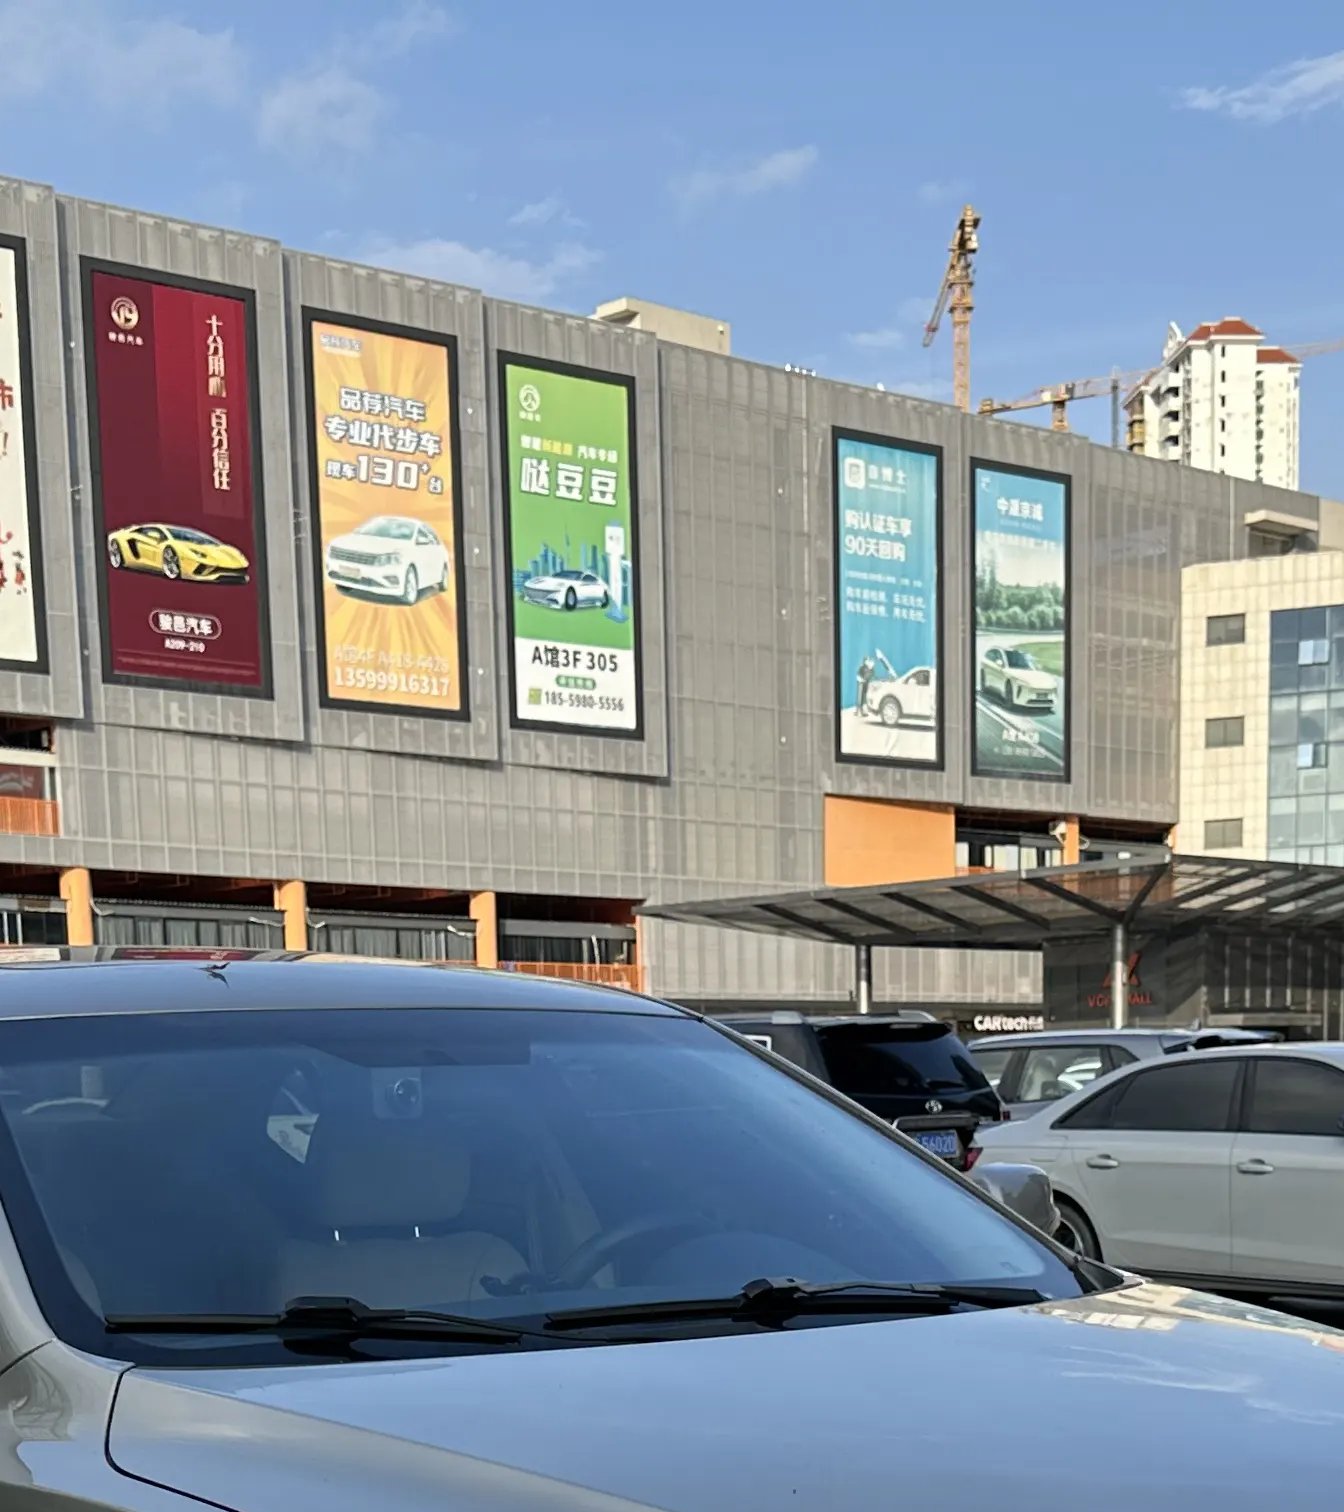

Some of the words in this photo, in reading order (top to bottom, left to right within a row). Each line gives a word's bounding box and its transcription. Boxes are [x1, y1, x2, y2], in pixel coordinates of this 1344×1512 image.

[339, 386, 427, 422] 品荐汽车
[324, 414, 443, 458] 专业代步车
[519, 457, 618, 506] 哒豆豆
[532, 645, 582, 669] A馆3F
[586, 652, 619, 673] 305
